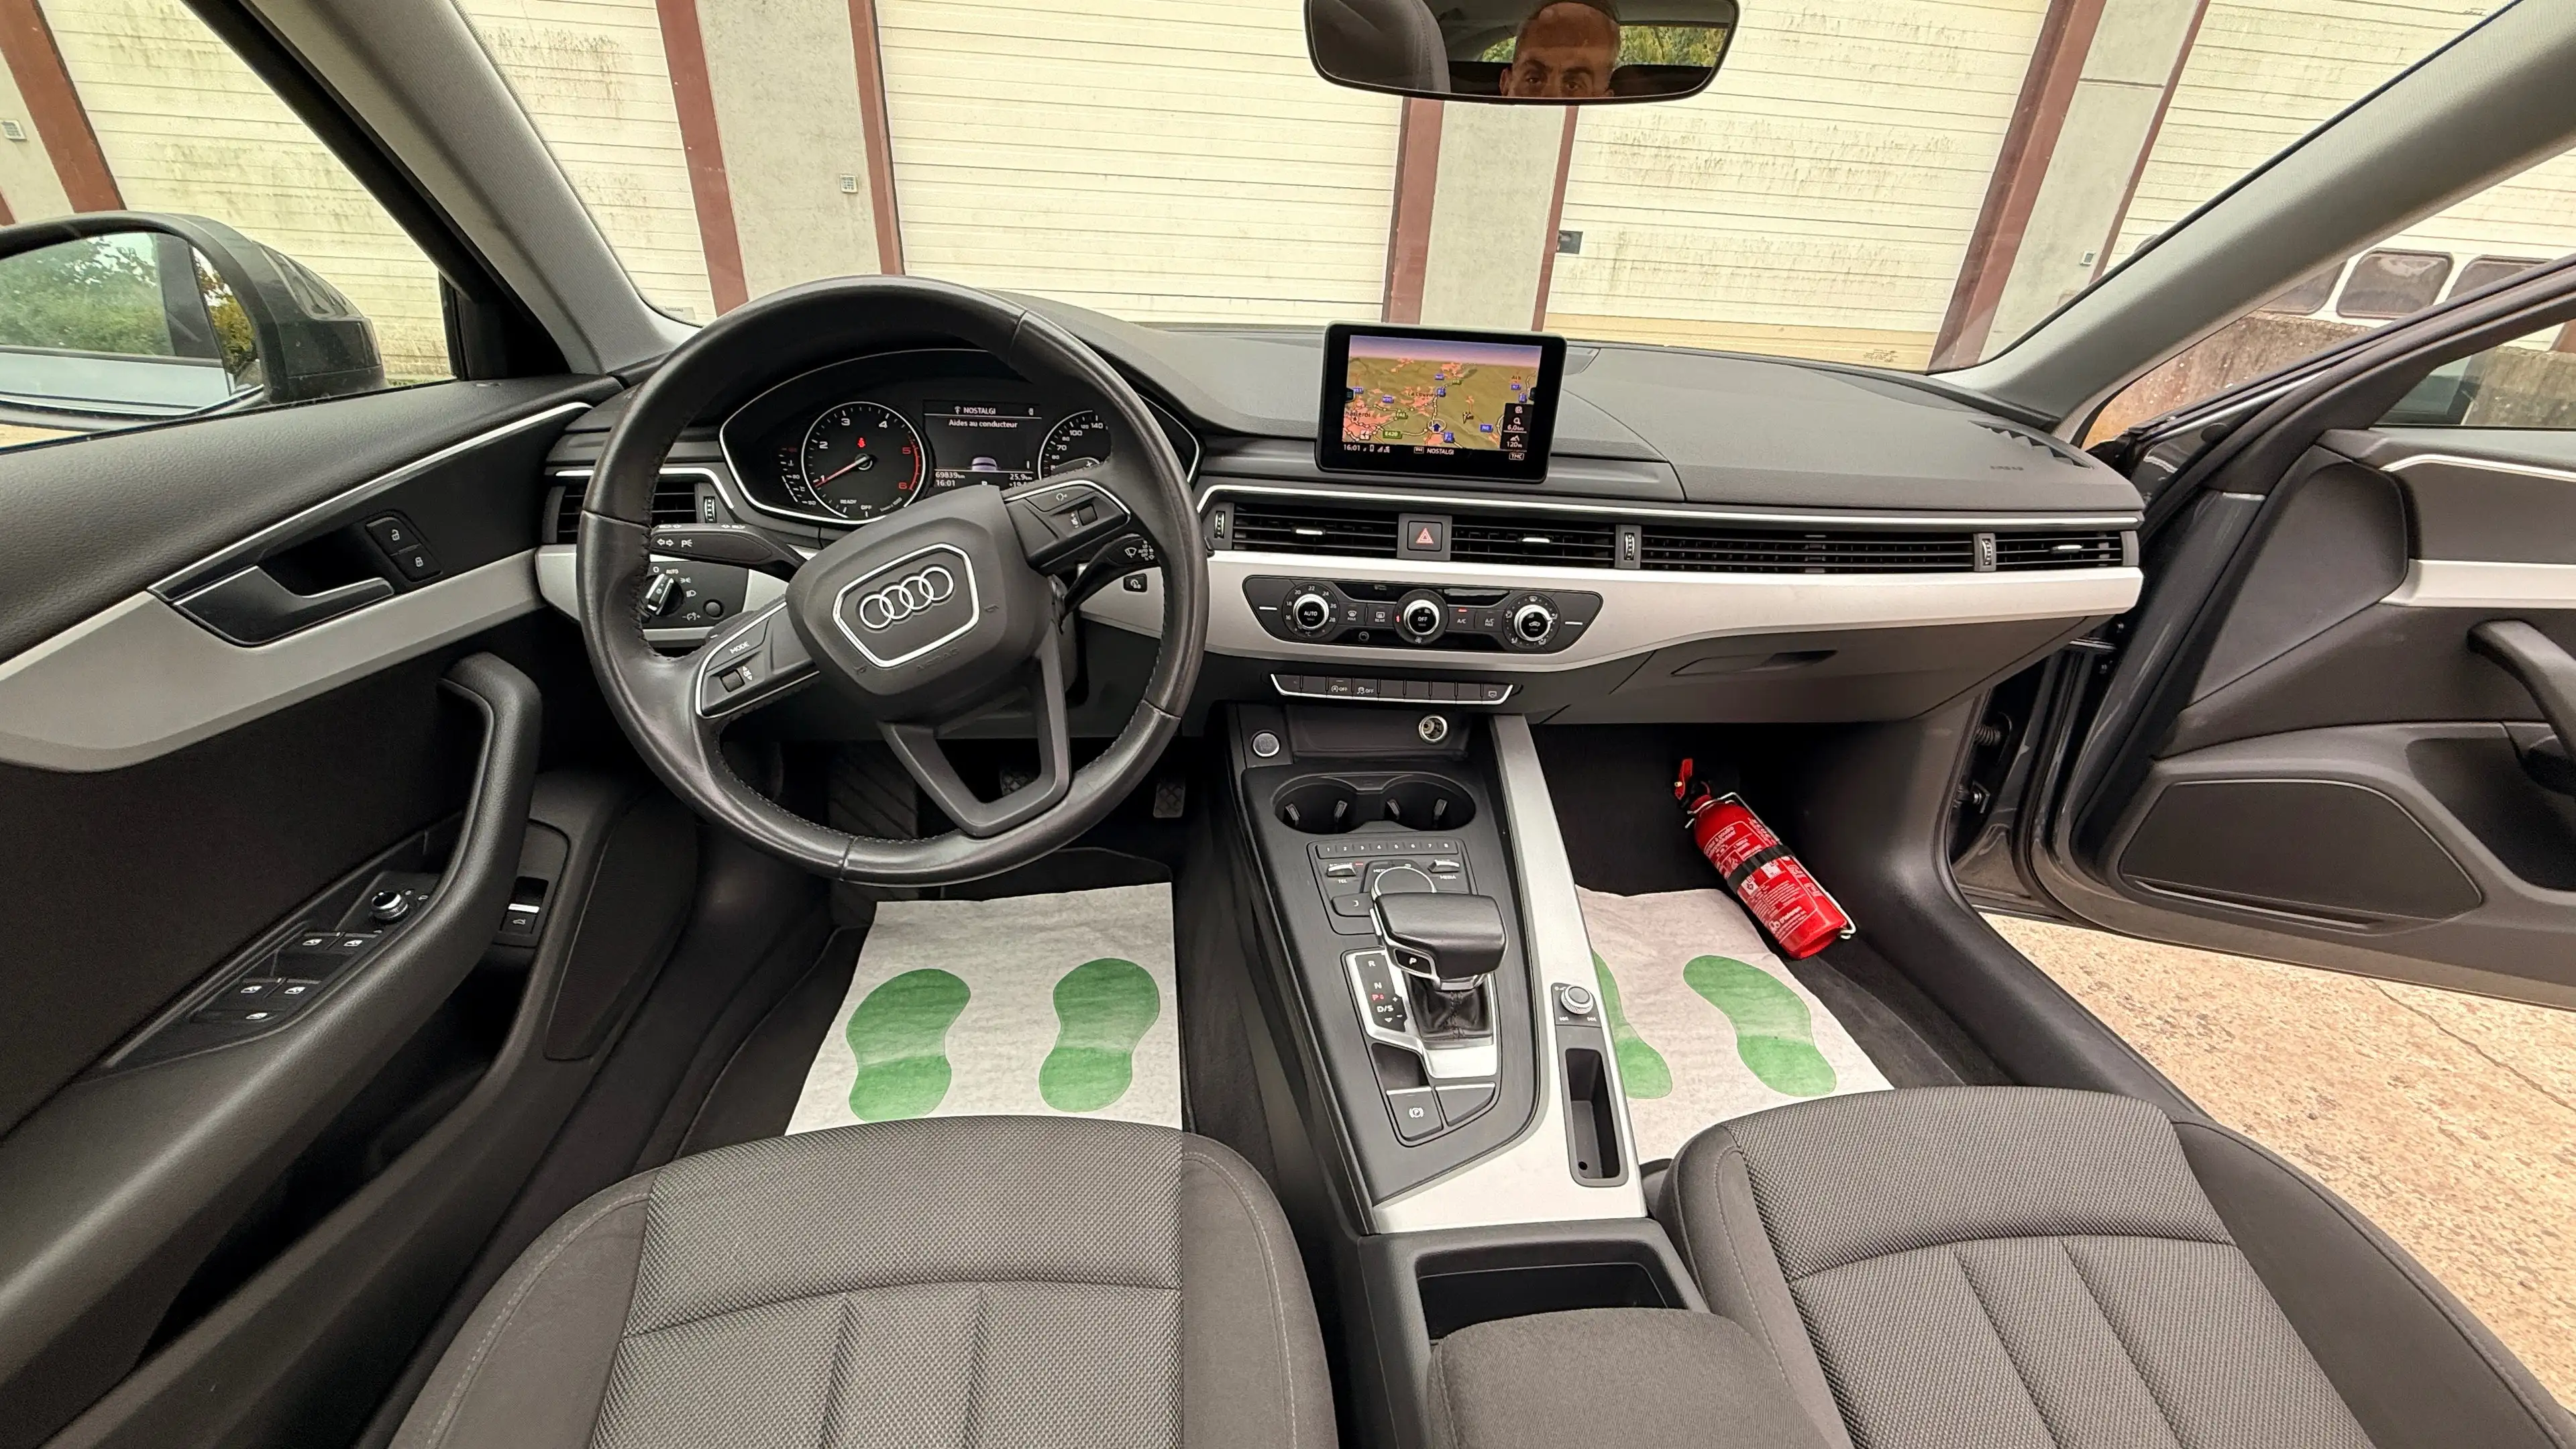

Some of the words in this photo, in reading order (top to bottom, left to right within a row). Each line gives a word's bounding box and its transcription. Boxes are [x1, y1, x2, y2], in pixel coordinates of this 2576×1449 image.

[963, 407, 996, 415] NOSTALGI
[841, 418, 851, 426] 3
[878, 420, 888, 429] 4
[949, 419, 968, 427] Aides
[819, 441, 828, 449] 2
[1427, 447, 1454, 455] NOSTALGI
[729, 641, 750, 654] MODE
[1373, 981, 1383, 989] N
[1377, 1005, 1394, 1013] D/S
